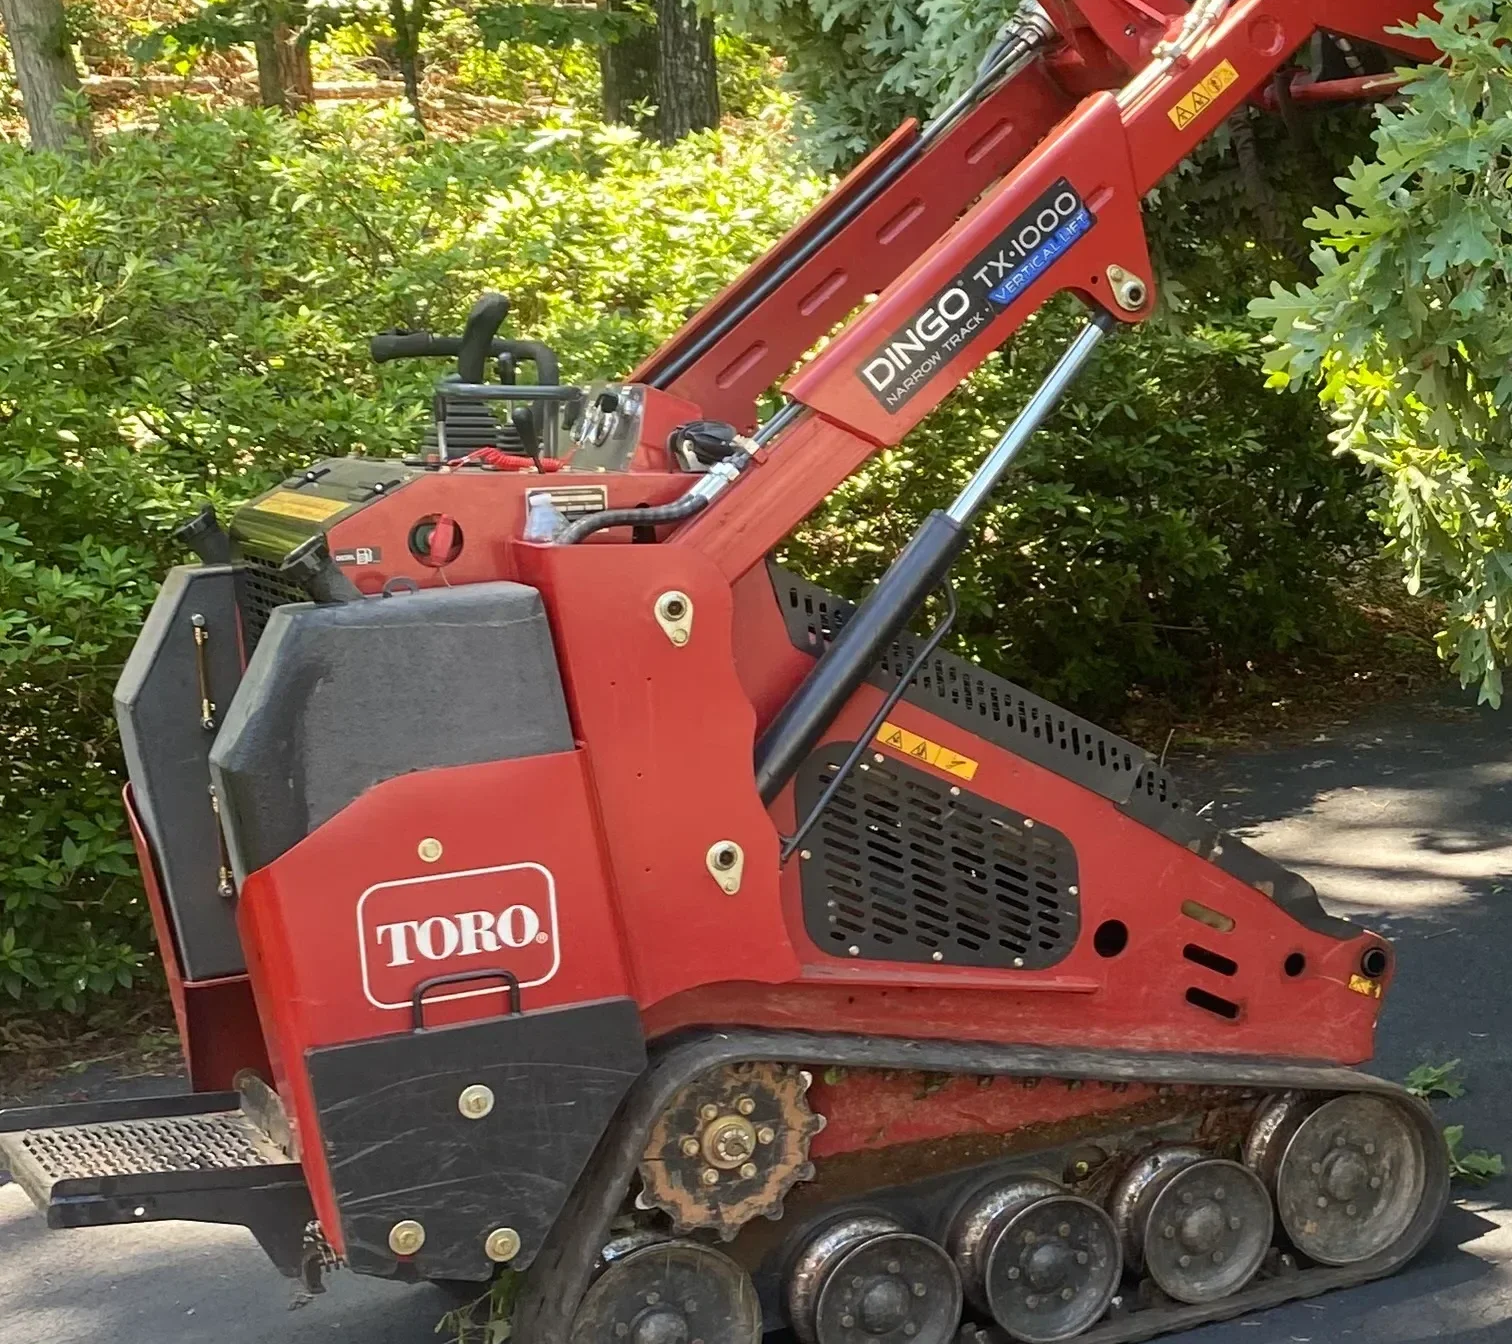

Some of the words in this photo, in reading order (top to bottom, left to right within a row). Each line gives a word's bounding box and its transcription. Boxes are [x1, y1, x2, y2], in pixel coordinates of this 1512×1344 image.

[995, 239, 1061, 302] VERTICAL
[1060, 213, 1089, 244] LIFT
[861, 287, 970, 392] DINGO
[886, 350, 942, 406] NARROW
[941, 311, 985, 352] TRACK
[376, 905, 539, 967] TORO
